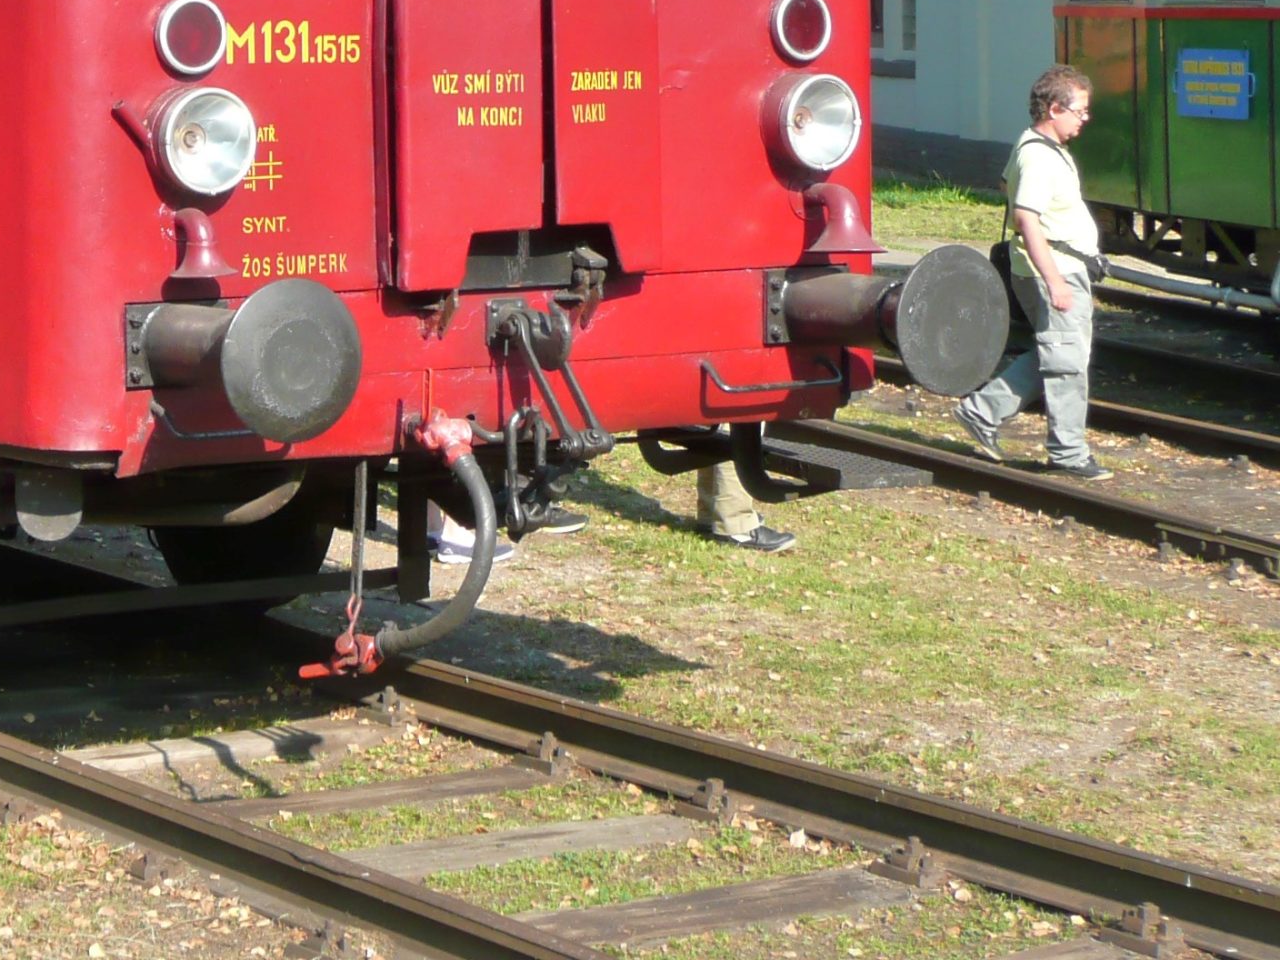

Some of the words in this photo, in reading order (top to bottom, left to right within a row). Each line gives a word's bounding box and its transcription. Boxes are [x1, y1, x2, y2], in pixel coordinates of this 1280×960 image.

[432, 69, 459, 94] VŮZ
[464, 69, 491, 93] SMÍ
[495, 69, 525, 93] BÝTI
[622, 70, 642, 90] JEN
[457, 106, 475, 127] NA
[480, 106, 523, 127] KONCI
[571, 103, 606, 124] VLAKU
[242, 216, 290, 234] SYNT.
[242, 253, 271, 278] ŽOS
[276, 252, 348, 275] ŠUMPERK
